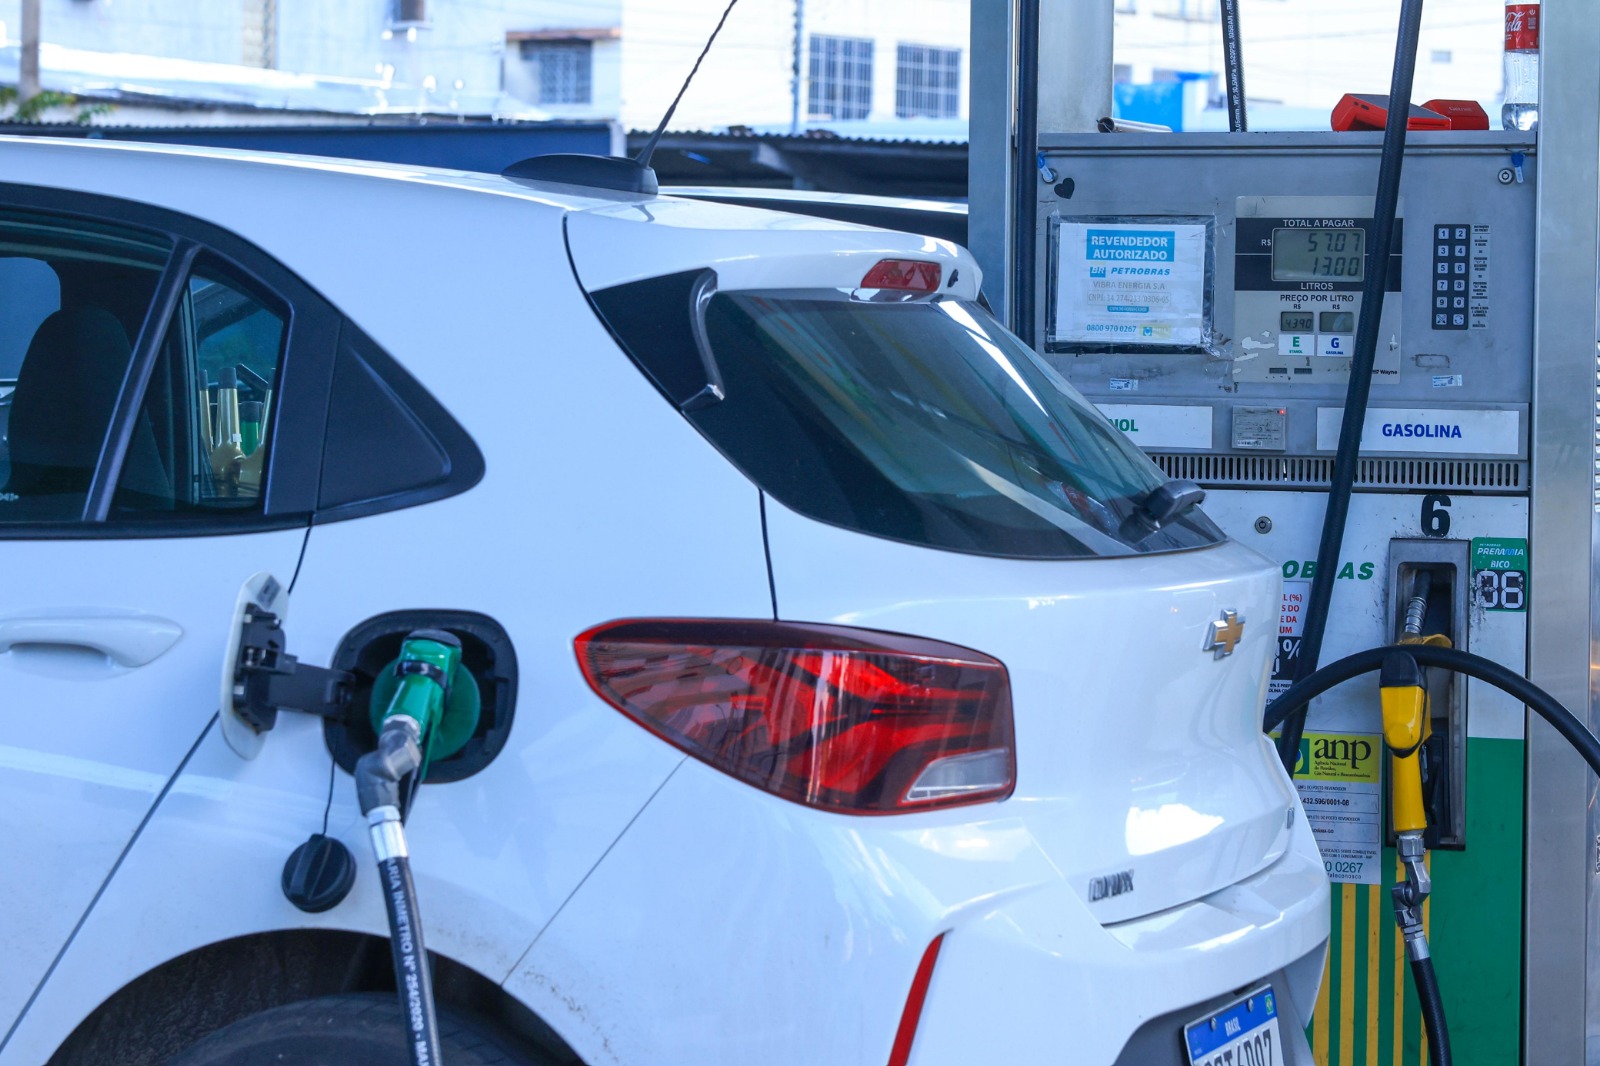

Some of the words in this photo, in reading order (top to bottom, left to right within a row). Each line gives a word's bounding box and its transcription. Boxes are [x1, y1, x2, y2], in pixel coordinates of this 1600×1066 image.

[1091, 236, 1168, 247] REVENDEDOR
[1093, 249, 1168, 260] AUTORIZADO
[1111, 267, 1170, 275] PETROBRAS
[1293, 336, 1299, 347] E
[1331, 338, 1339, 348] G
[1382, 424, 1462, 438] GASOLINA
[1420, 494, 1452, 538] 6
[1290, 594, 1302, 602] (%)
[1314, 738, 1371, 770] anp
[1336, 862, 1363, 873] 0267
[392, 891, 413, 953] INMETRO
